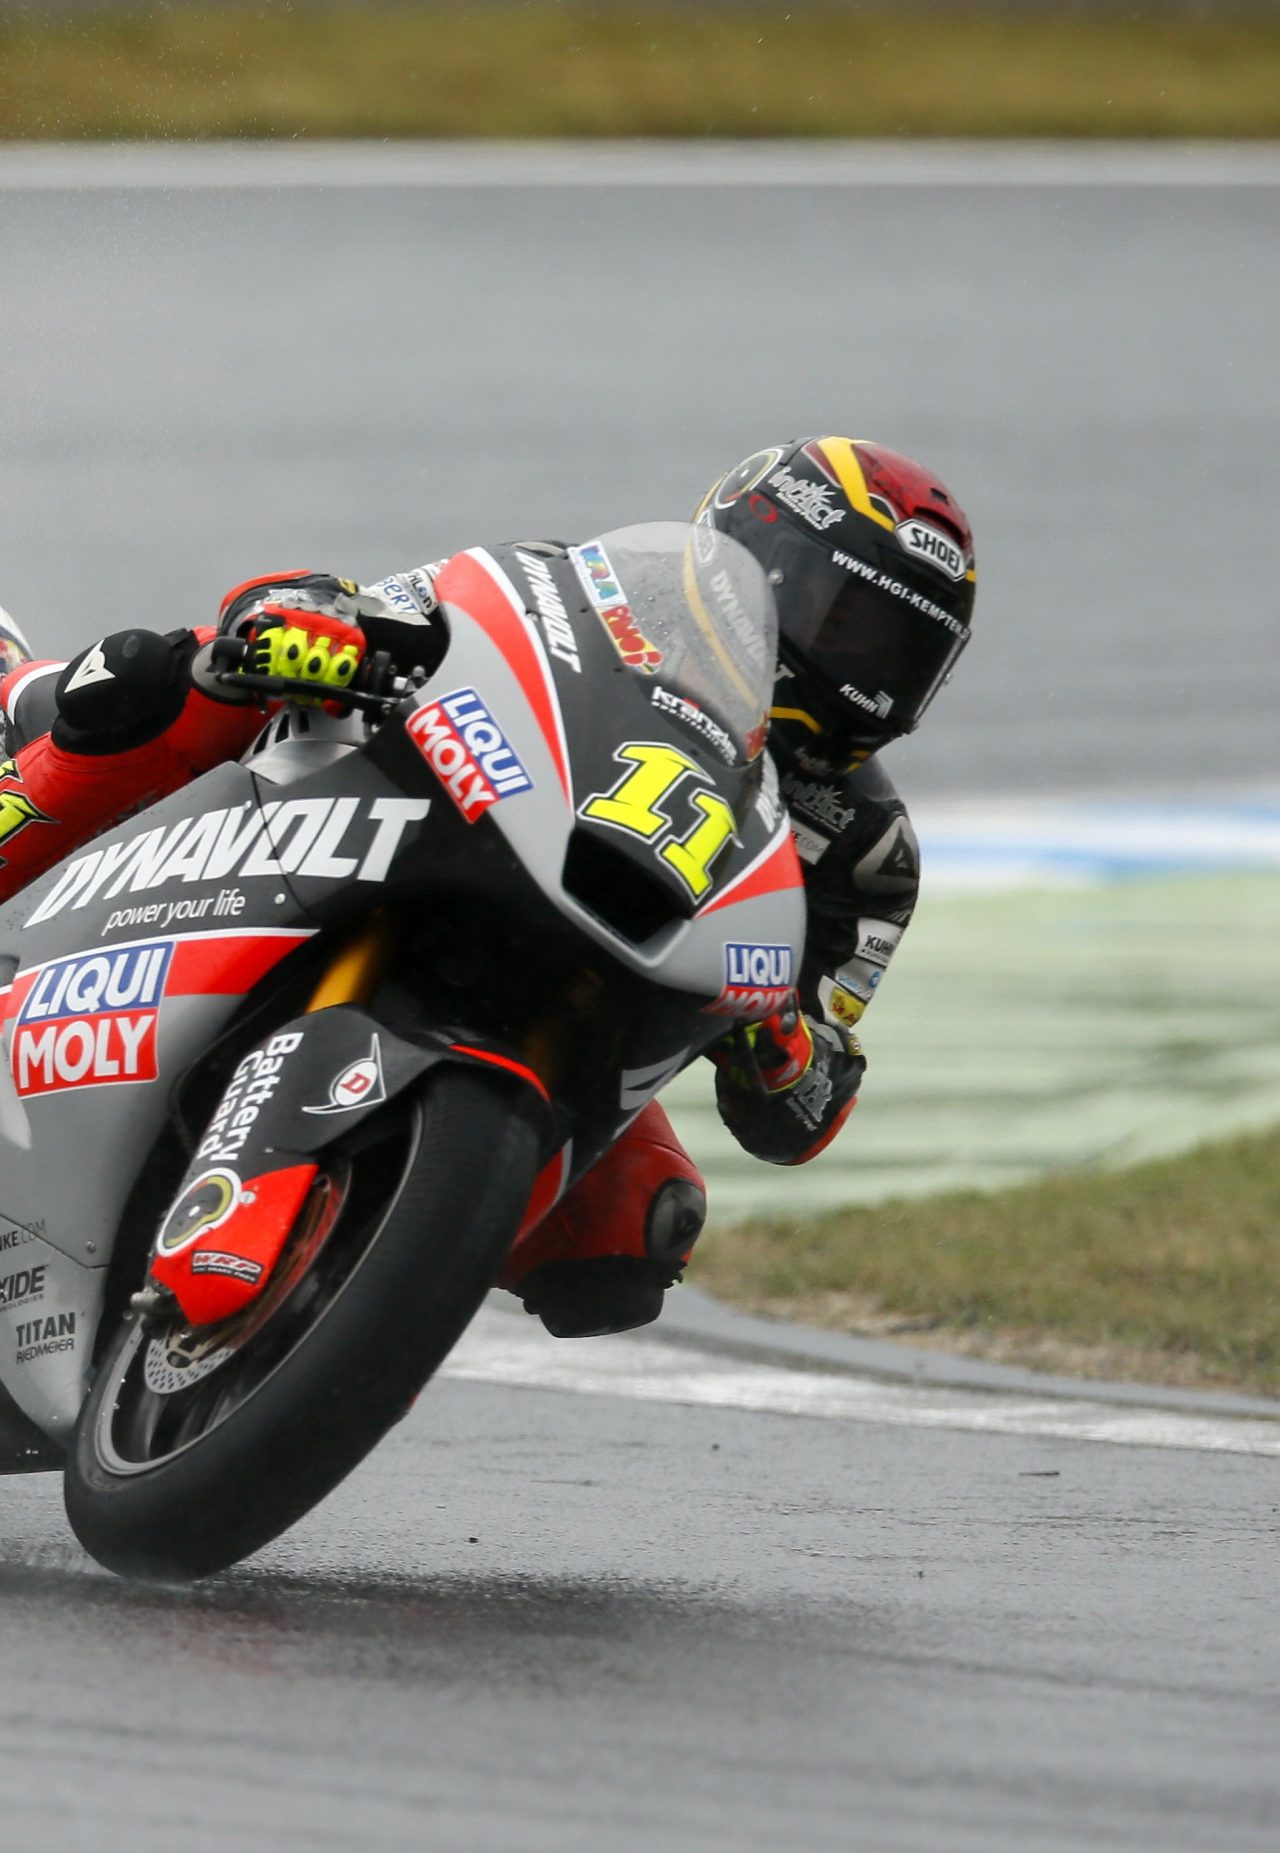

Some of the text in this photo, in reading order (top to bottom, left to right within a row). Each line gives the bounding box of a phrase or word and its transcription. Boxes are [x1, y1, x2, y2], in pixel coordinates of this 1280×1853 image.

[910, 527, 961, 572] SHOEI
[839, 683, 880, 713] KUHN
[411, 707, 495, 814] MOLY
[445, 693, 531, 793] LIQUI
[577, 742, 743, 904] 11
[23, 797, 432, 929] DYNAVOLT
[102, 889, 246, 935] power your life
[26, 947, 167, 1020] LIQUI
[728, 946, 791, 986] LIQUI
[20, 1015, 155, 1089] MOLY
[340, 1073, 372, 1094] D
[197, 1051, 262, 1160] Guard
[210, 1032, 304, 1161] Battery
[16, 1312, 76, 1347] TITAN
